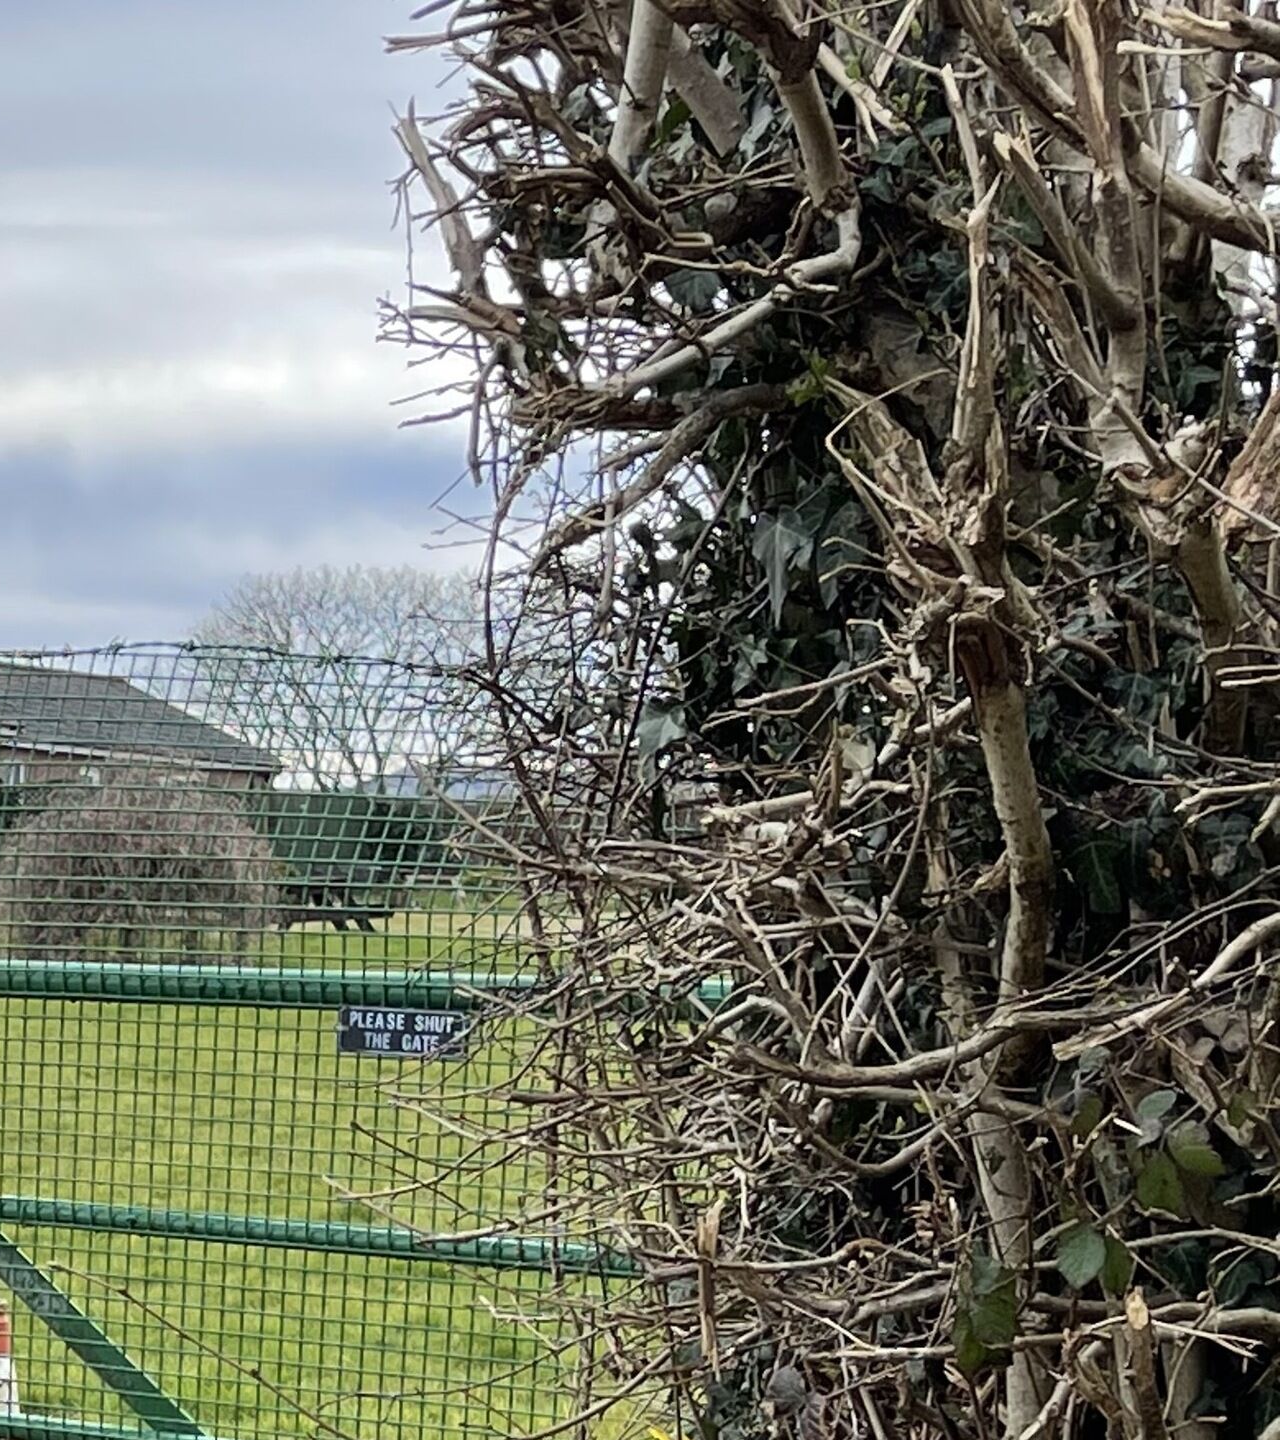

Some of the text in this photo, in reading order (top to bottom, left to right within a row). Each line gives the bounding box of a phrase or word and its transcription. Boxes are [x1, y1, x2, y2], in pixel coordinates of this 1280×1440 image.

[349, 1011, 454, 1033] PLEASE SHUT
[364, 1032, 440, 1051] THE GATE
